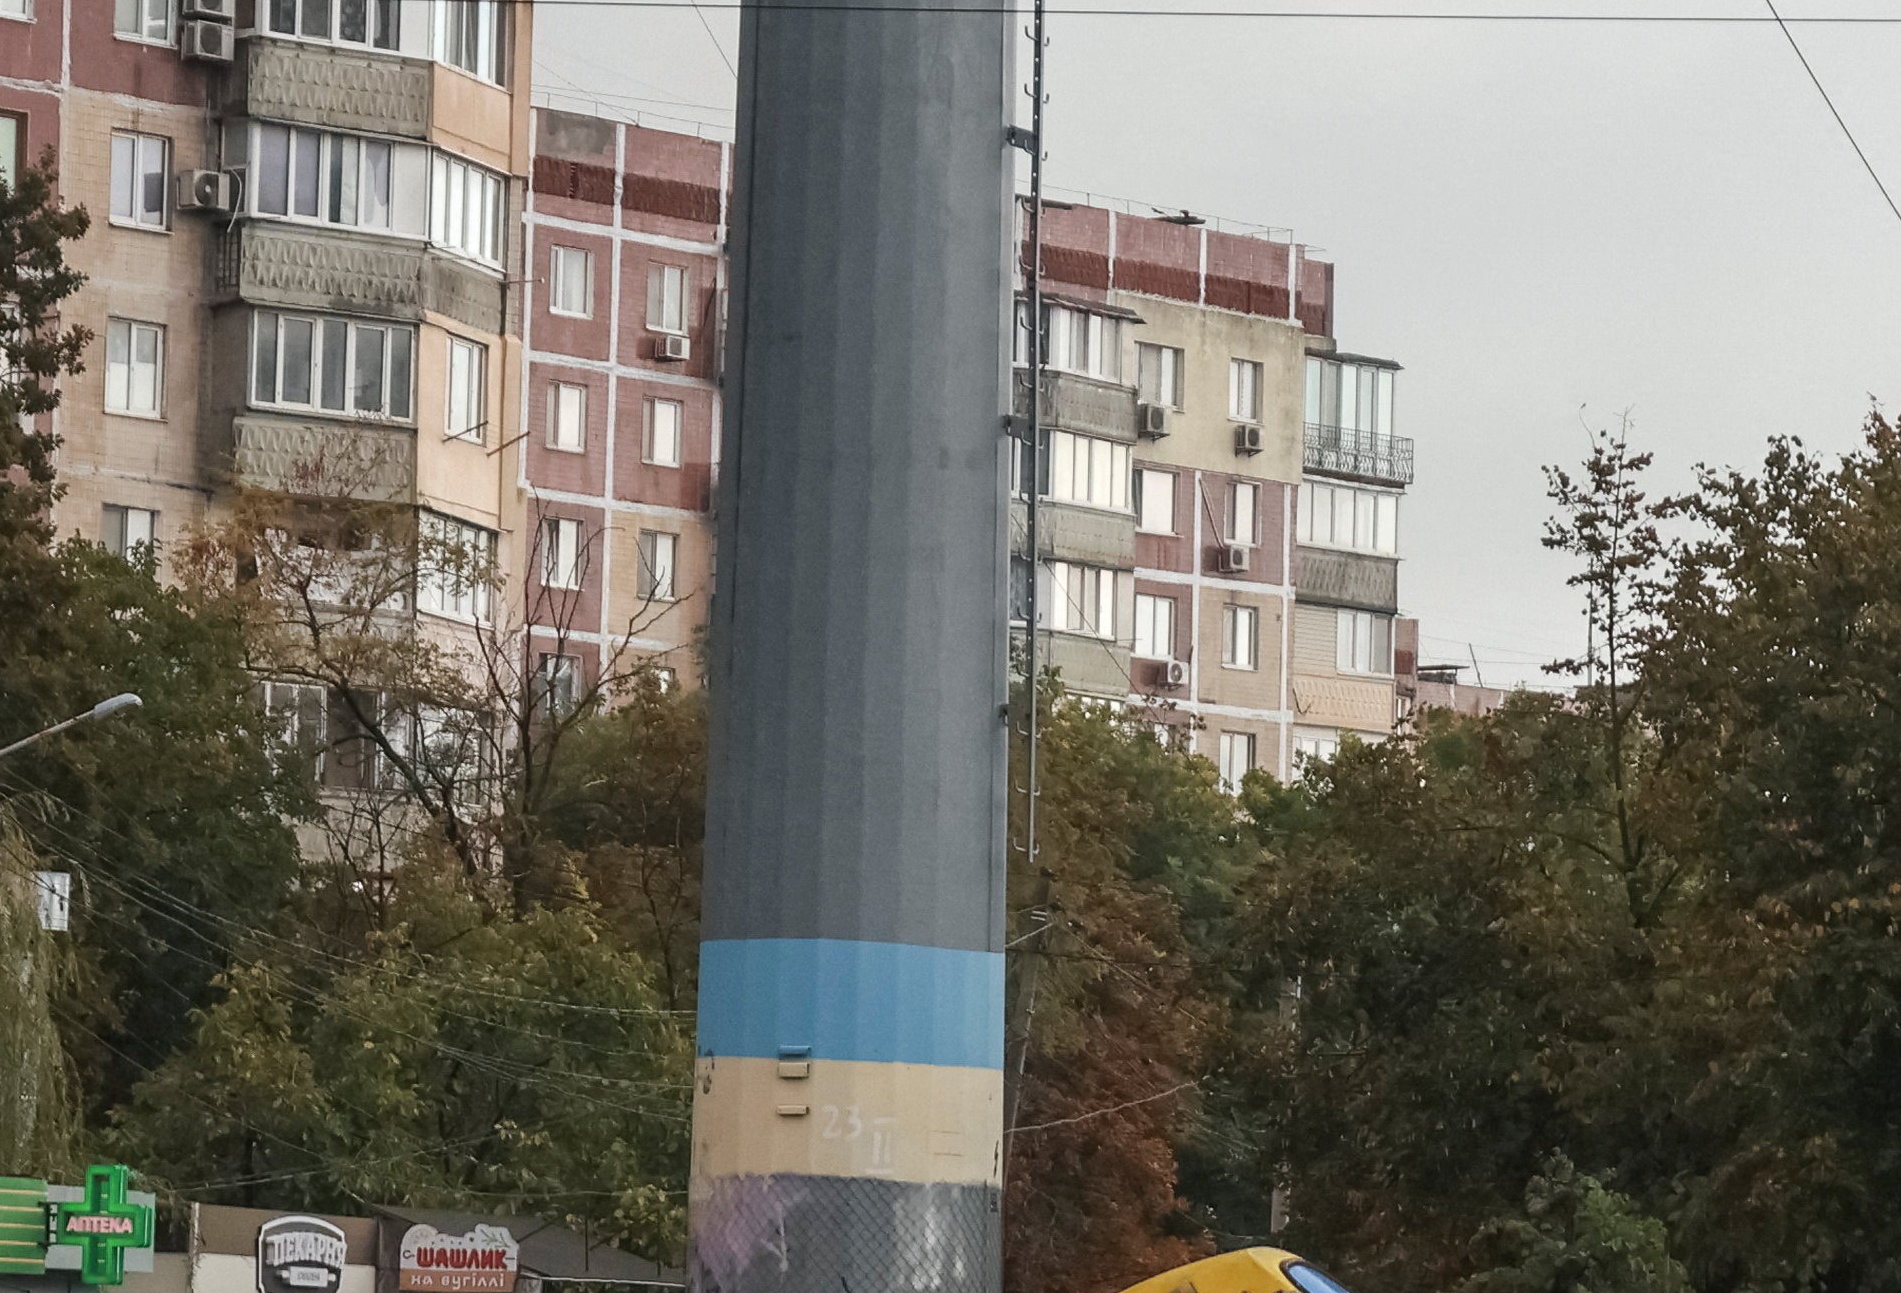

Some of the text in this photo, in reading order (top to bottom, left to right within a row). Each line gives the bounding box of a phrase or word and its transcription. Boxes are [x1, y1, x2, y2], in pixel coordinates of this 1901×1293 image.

[66, 1215, 133, 1234] АПТЕКА
[266, 1232, 346, 1269] ПЕКАРНЯ
[416, 1246, 508, 1270] ШАШЛИК
[411, 1272, 506, 1291] на вугіллі
